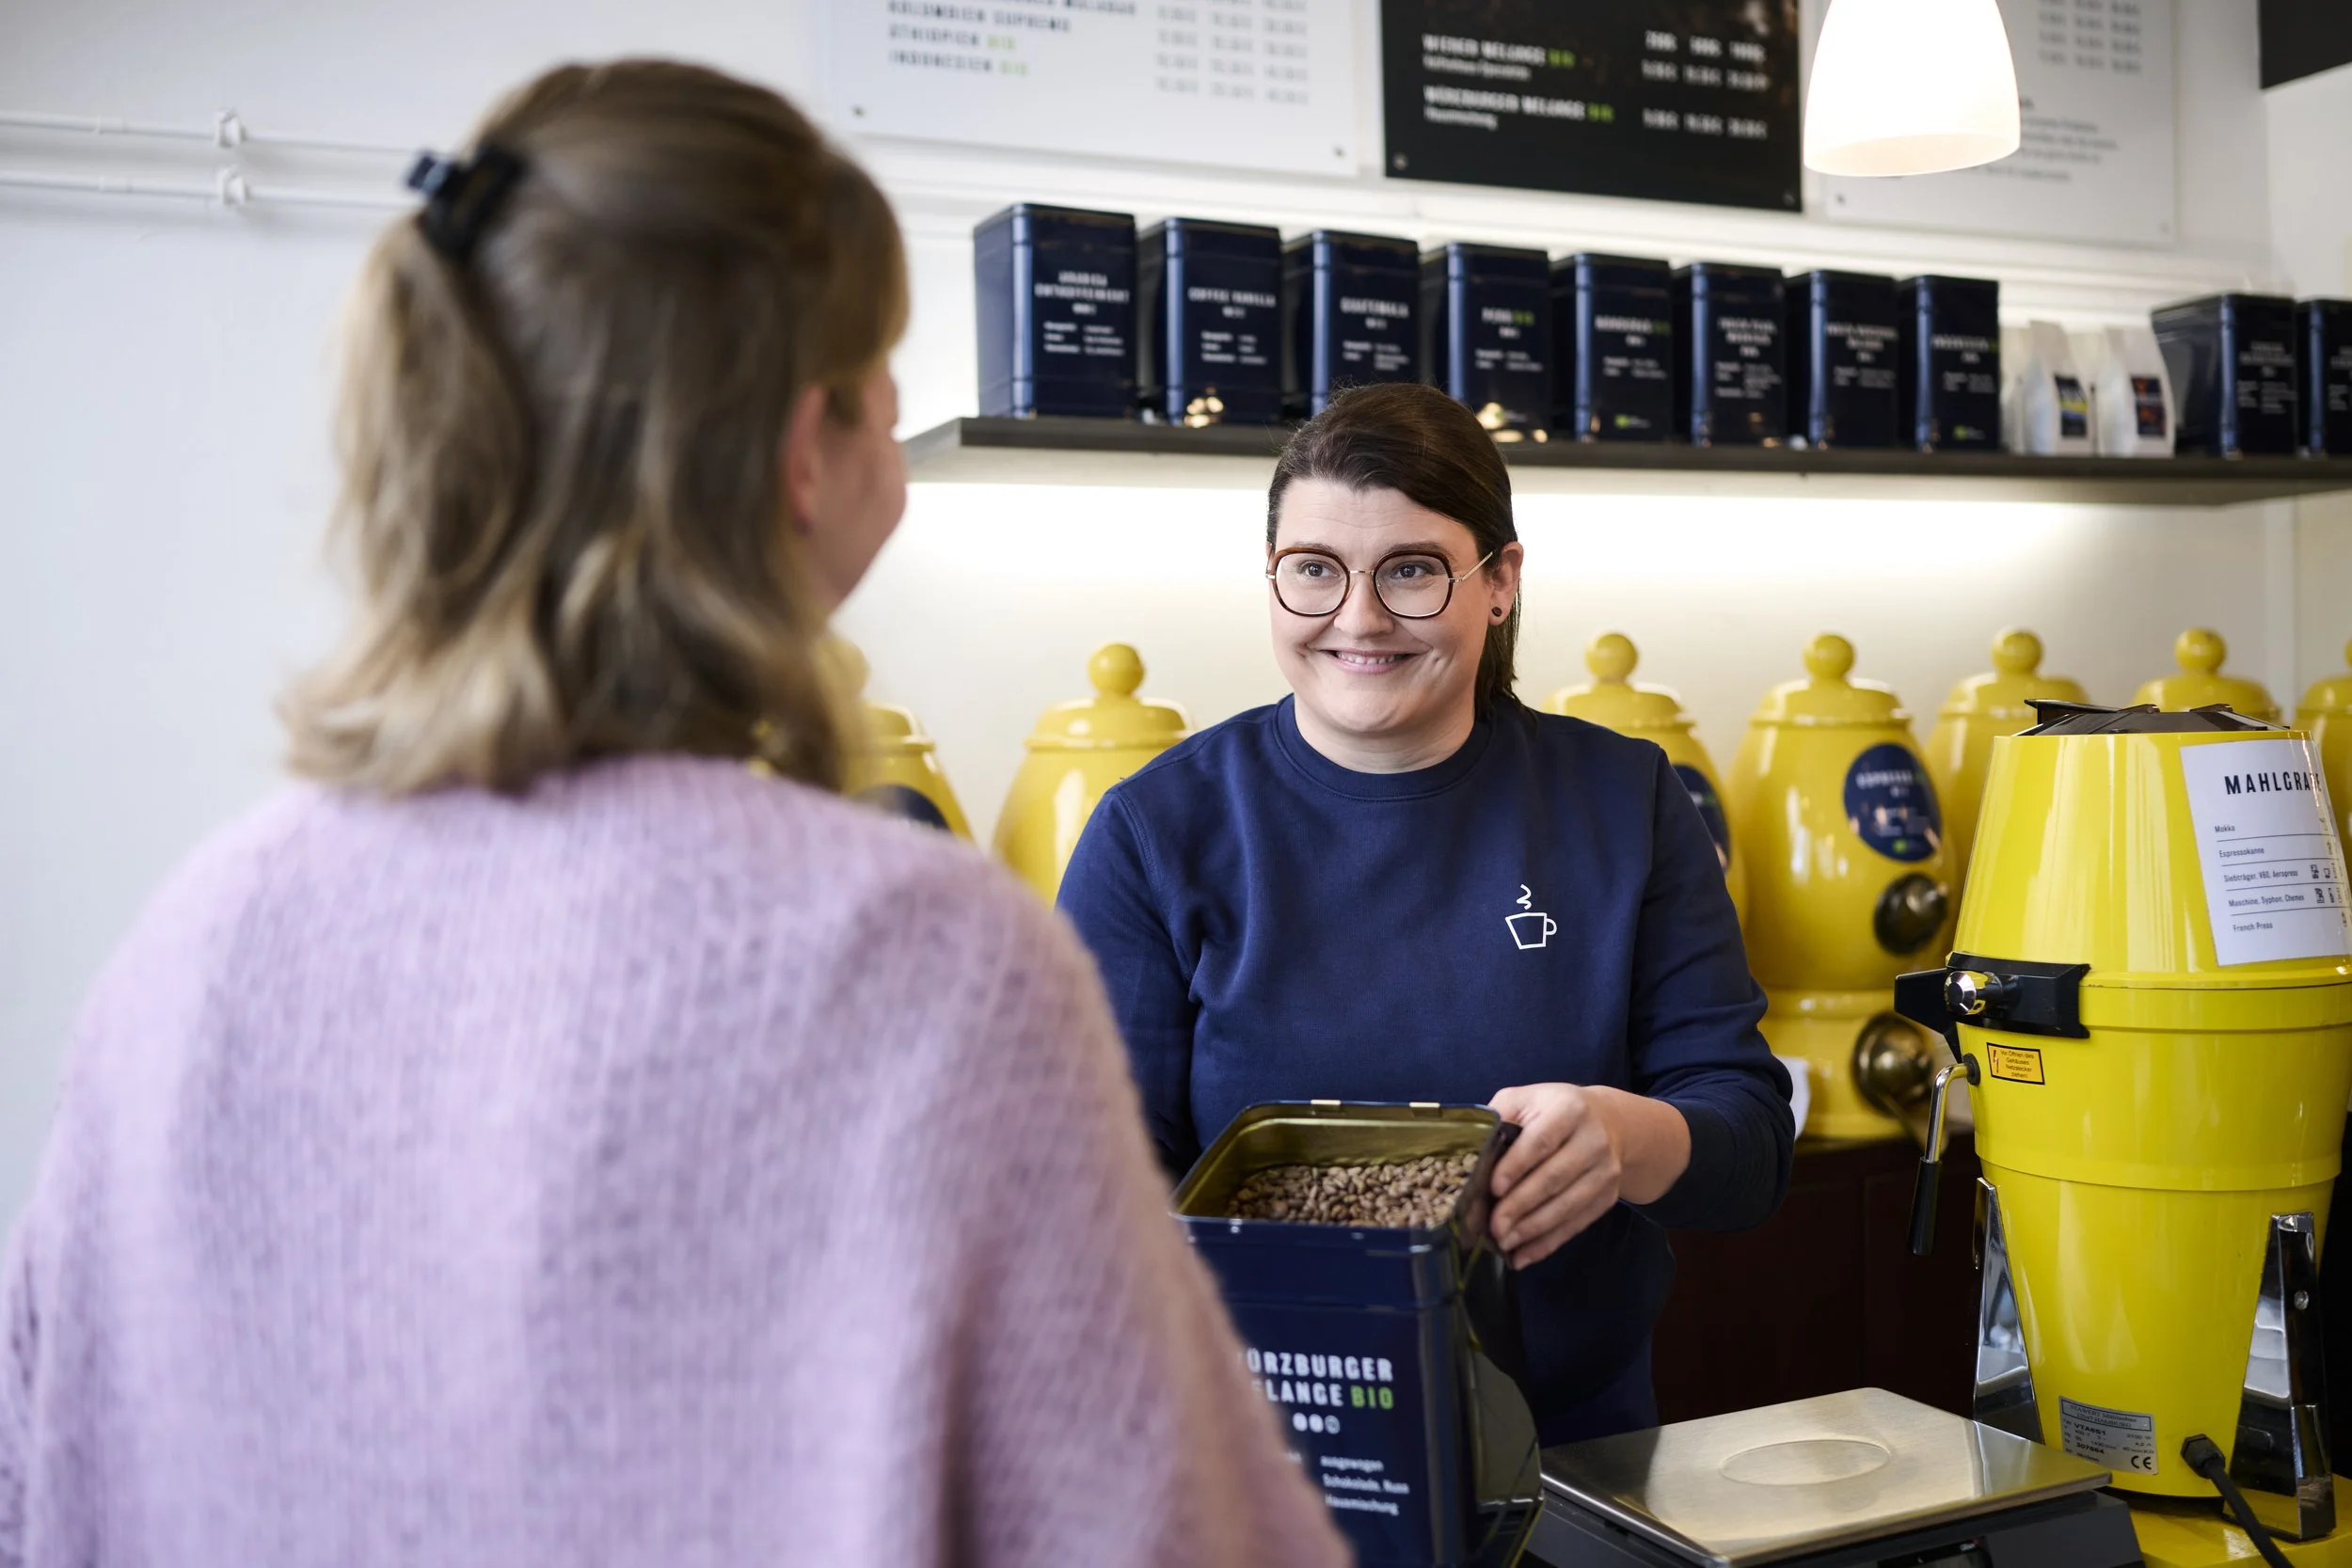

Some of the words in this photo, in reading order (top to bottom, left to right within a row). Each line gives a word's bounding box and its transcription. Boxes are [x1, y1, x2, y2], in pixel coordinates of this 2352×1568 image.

[2214, 824, 2235, 833] Mokka
[2219, 847, 2265, 859] Espressokanne
[2233, 923, 2255, 933] French
[2256, 921, 2273, 931] Press
[1240, 1347, 1394, 1382] ÜRZBURGER
[1349, 1385, 1394, 1409] BIO
